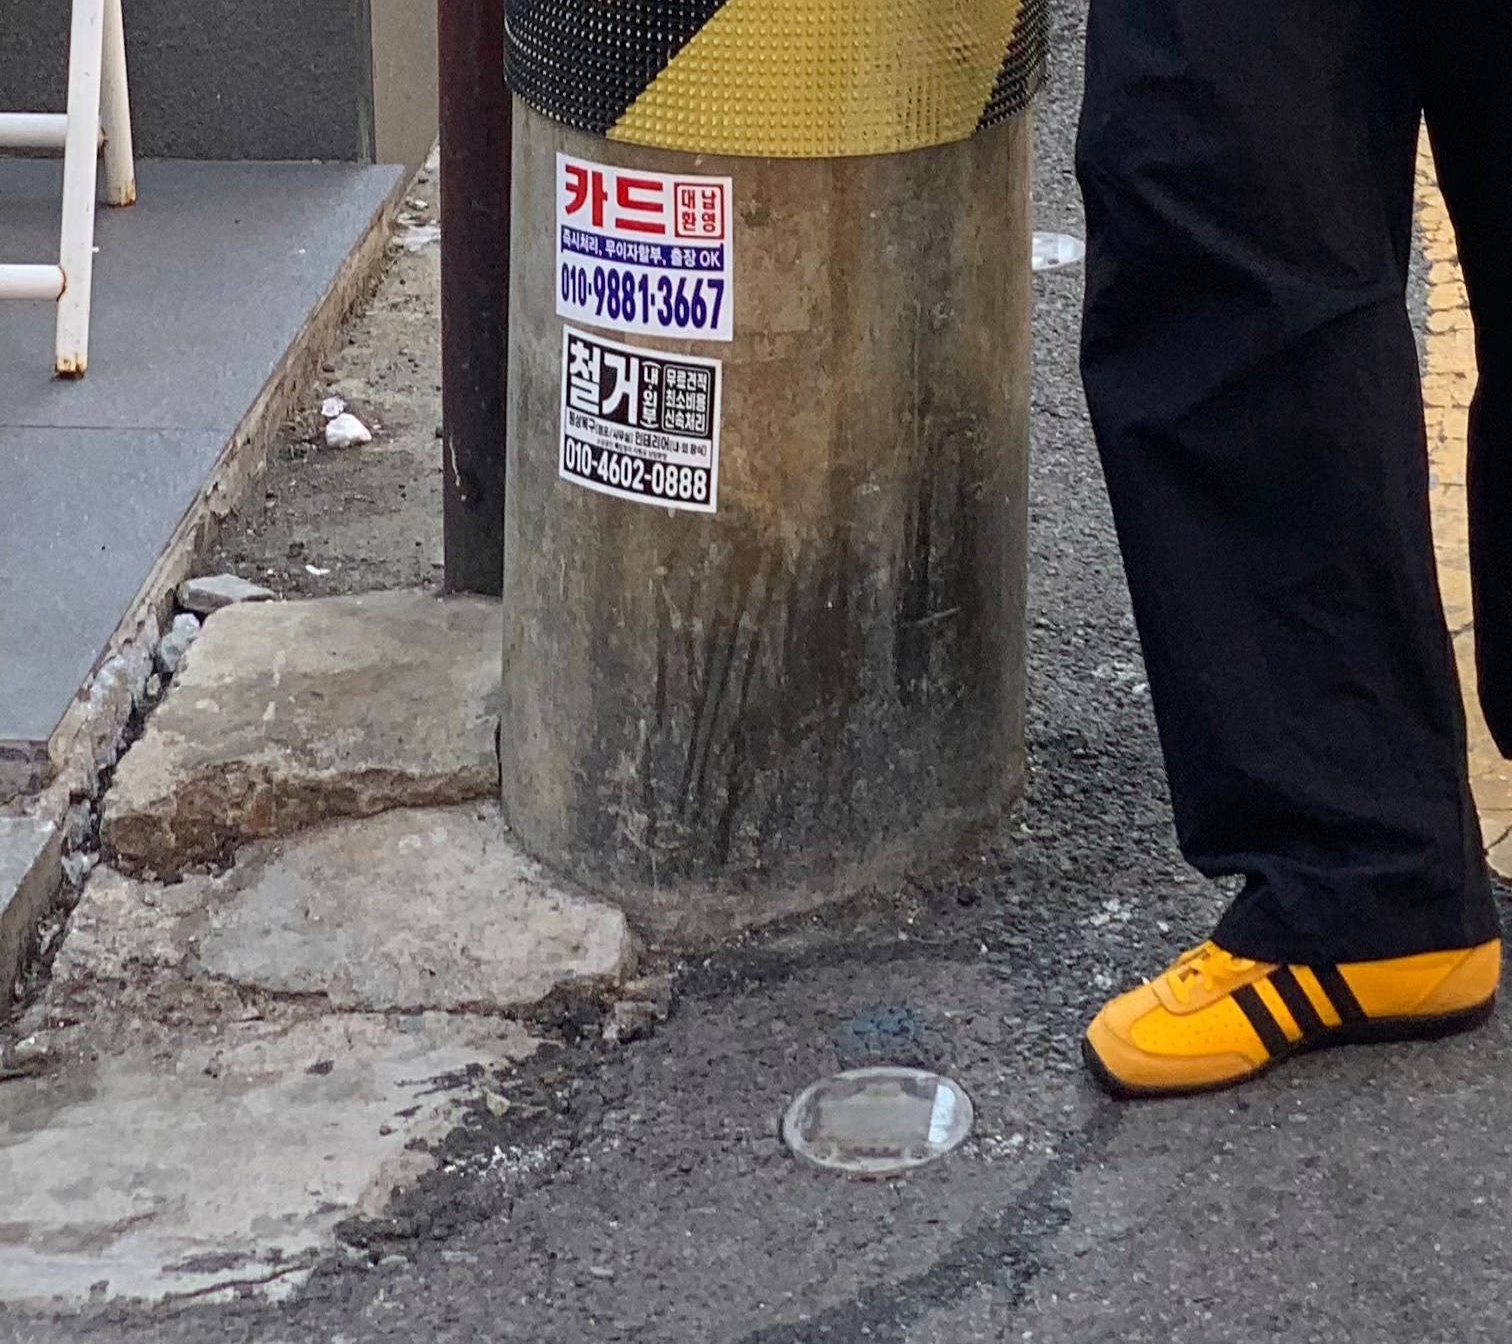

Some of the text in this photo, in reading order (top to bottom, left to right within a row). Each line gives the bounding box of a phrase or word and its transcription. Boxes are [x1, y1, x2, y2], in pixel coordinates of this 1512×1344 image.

[565, 163, 667, 235] 카드
[681, 189, 717, 210] 대납
[681, 212, 716, 233] 환영
[670, 247, 696, 268] 출장
[699, 250, 721, 268] OK
[569, 340, 640, 426] 철거
[665, 368, 707, 392] 무료견적
[665, 388, 707, 412] 최소비용
[664, 408, 706, 432] 신속처리
[565, 437, 707, 501] 010-4602-0888
